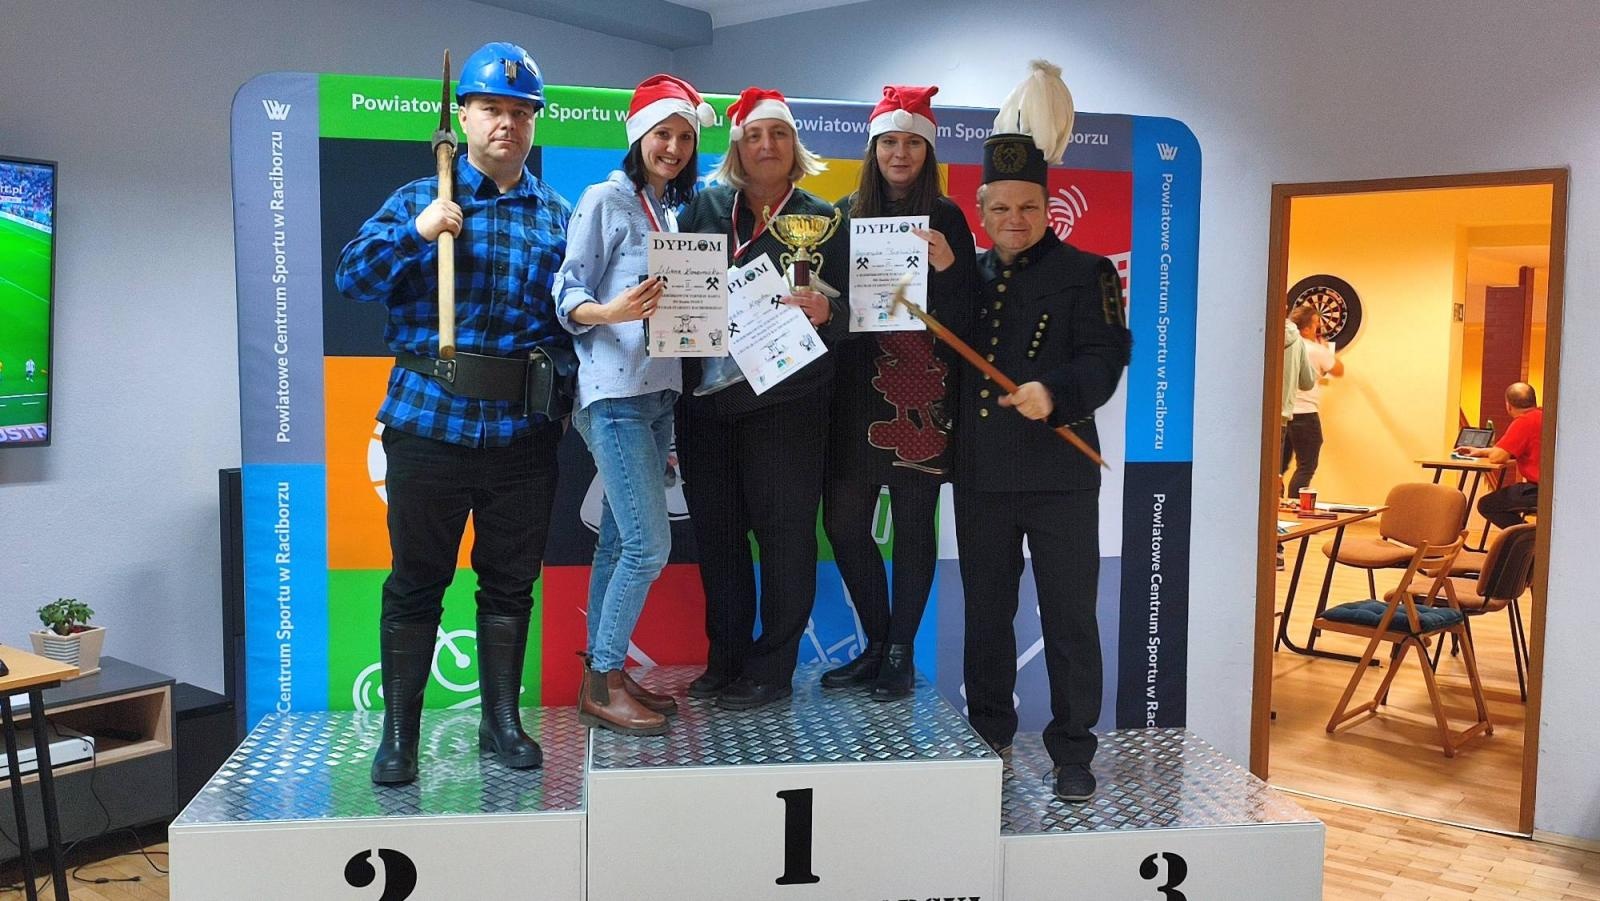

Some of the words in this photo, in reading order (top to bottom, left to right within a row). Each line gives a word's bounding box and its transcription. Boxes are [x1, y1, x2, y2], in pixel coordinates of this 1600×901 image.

[549, 103, 611, 122] Sportu
[795, 116, 870, 134] owiatow
[269, 131, 285, 210] Raciborzu
[273, 213, 285, 228] w
[1161, 173, 1174, 250] Powiatowe
[272, 231, 288, 284] Sportu
[653, 239, 722, 252] DYPLOM
[727, 262, 769, 294] PLOM
[1158, 254, 1172, 315] Centrum
[274, 286, 288, 355] Centrum
[1156, 316, 1170, 363] Sportu
[1156, 366, 1168, 379] w
[276, 357, 291, 443] Powiatowe
[1154, 381, 1168, 450] Raciborzu
[275, 481, 290, 564] Raciborzu
[1151, 493, 1166, 571] Powiatowe
[279, 567, 291, 583] w
[276, 586, 294, 640] Sportu
[1149, 575, 1163, 634] Centrum
[276, 643, 292, 715] Centrum
[1147, 636, 1161, 683] Sportu
[1147, 685, 1157, 699] w
[775, 788, 821, 885] 1
